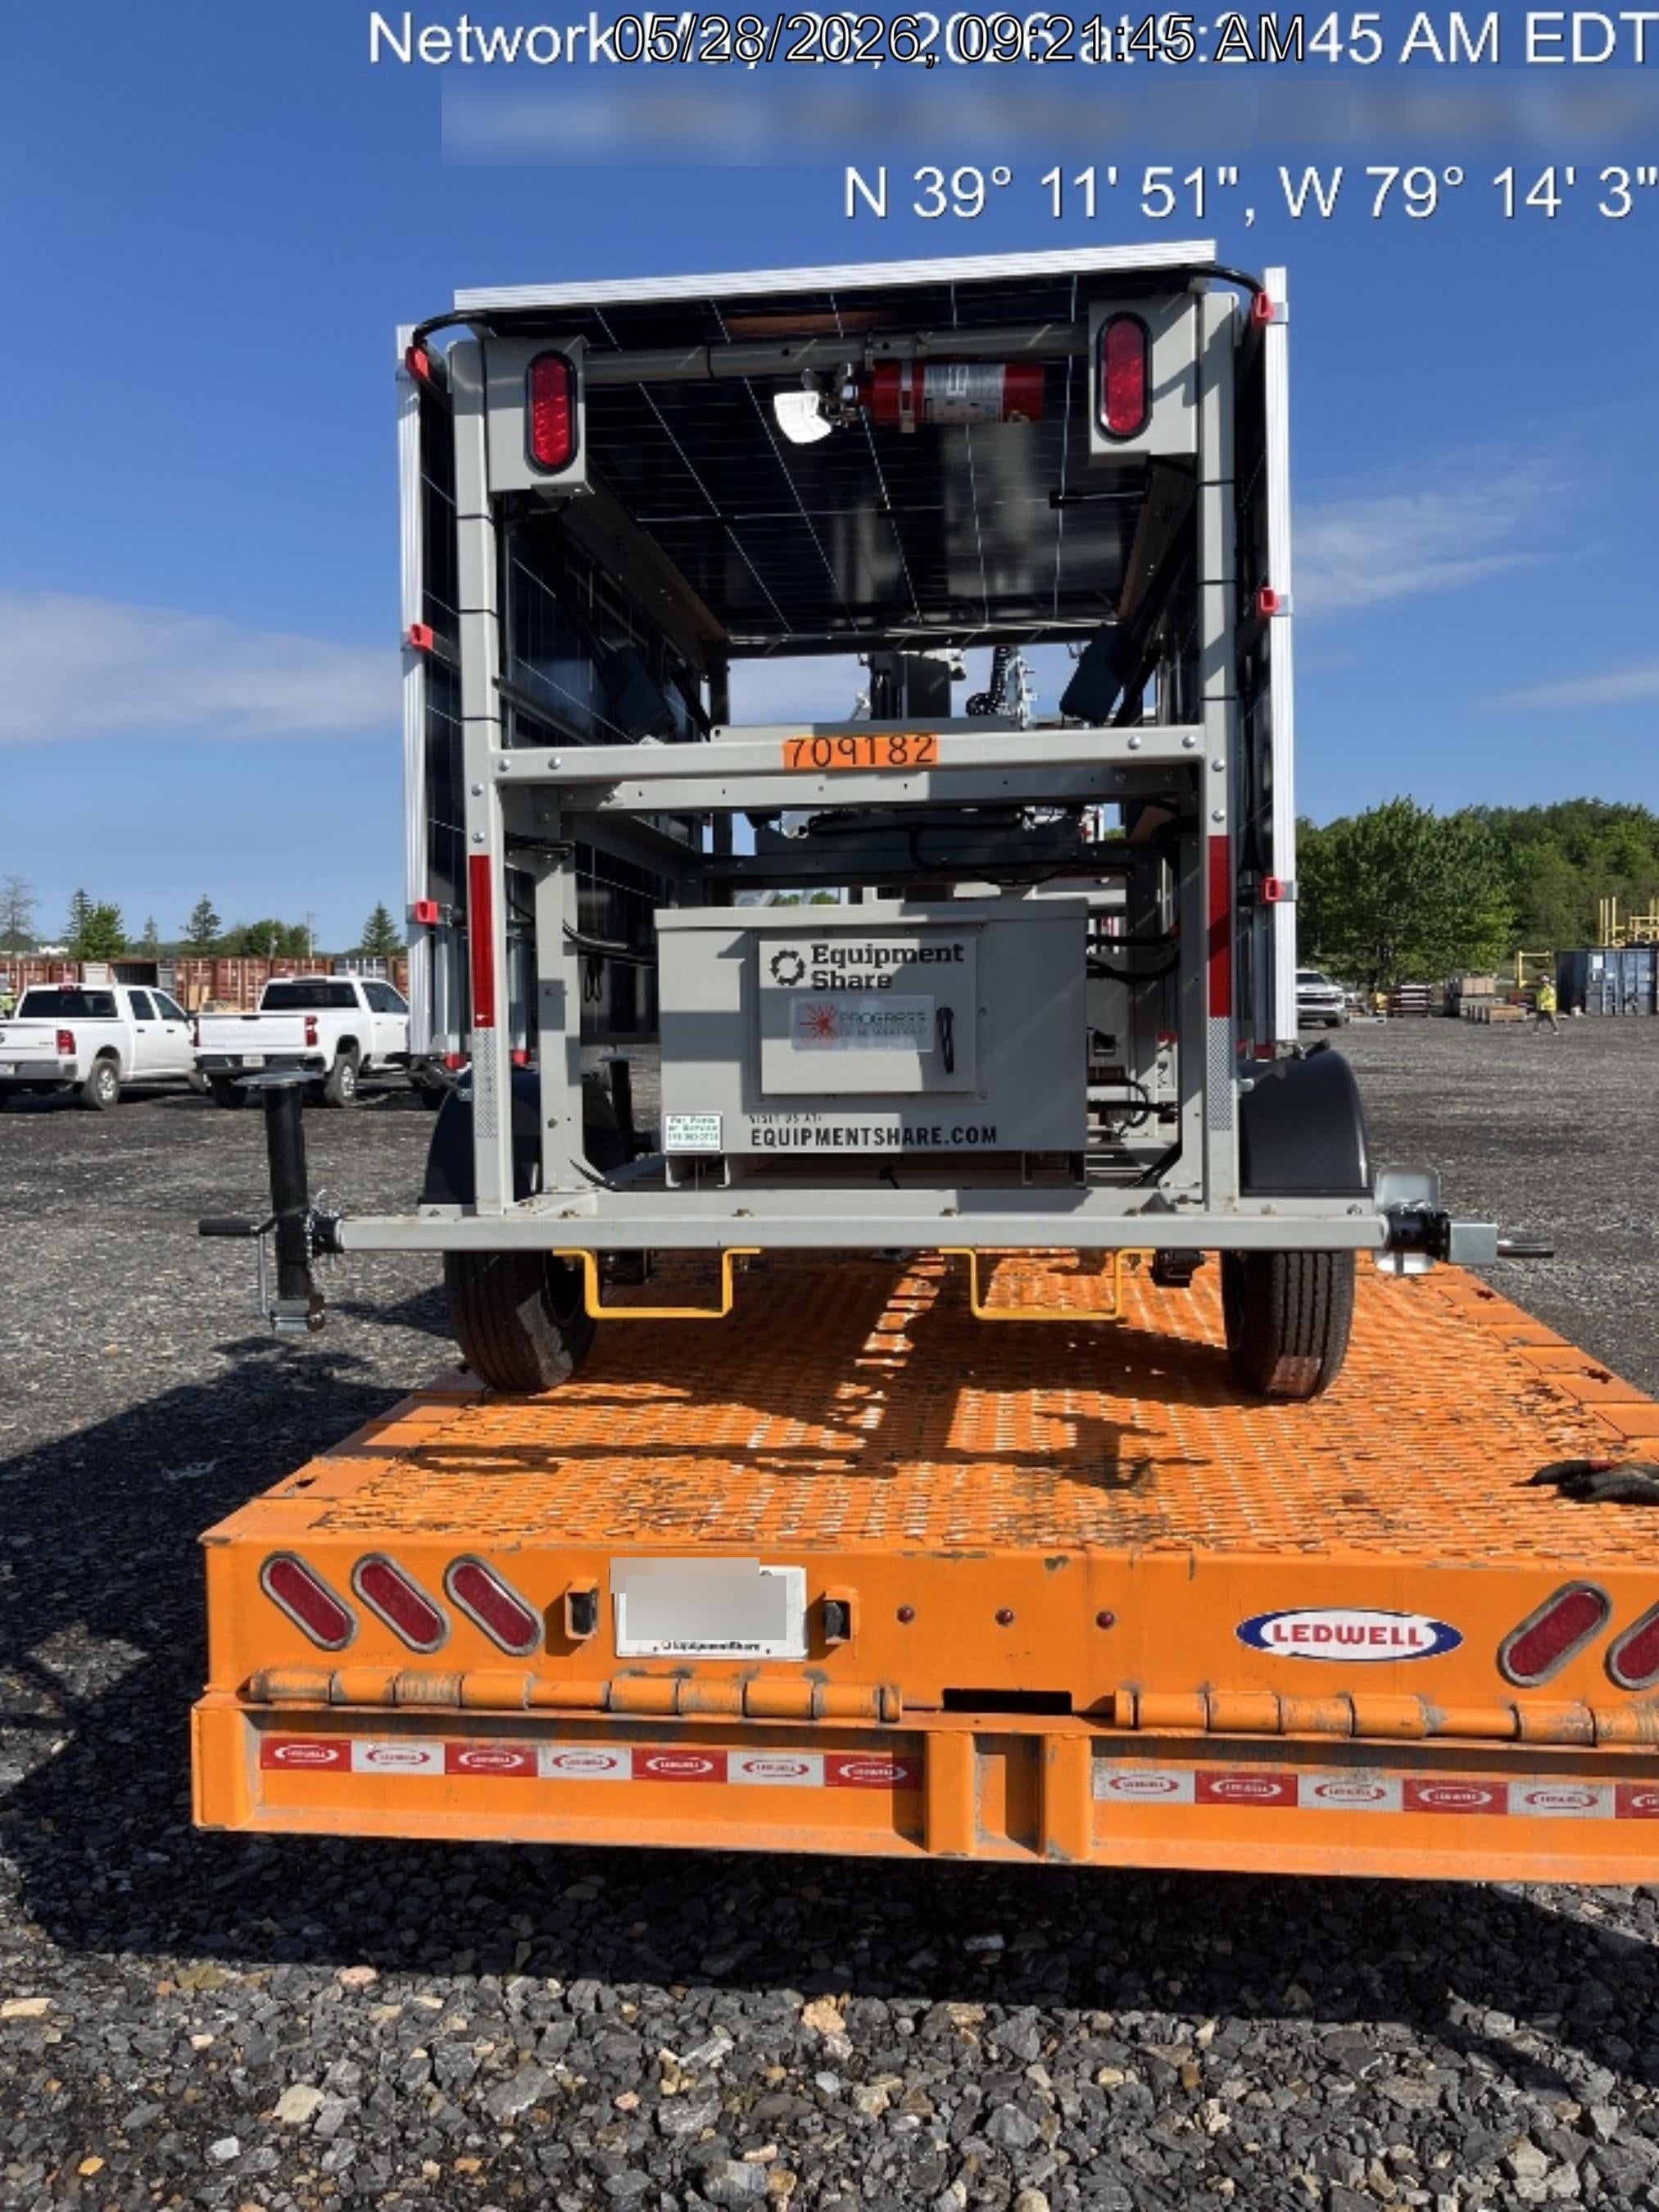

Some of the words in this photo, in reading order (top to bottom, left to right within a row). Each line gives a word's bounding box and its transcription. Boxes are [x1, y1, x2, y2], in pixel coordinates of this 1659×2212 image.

[787, 732, 934, 768] 709182
[810, 943, 964, 968] Equipment
[810, 970, 894, 990] Share
[750, 1125, 997, 1148] EQUIPMENTSHARE.COM
[1272, 1624, 1424, 1647] LEDWELL
